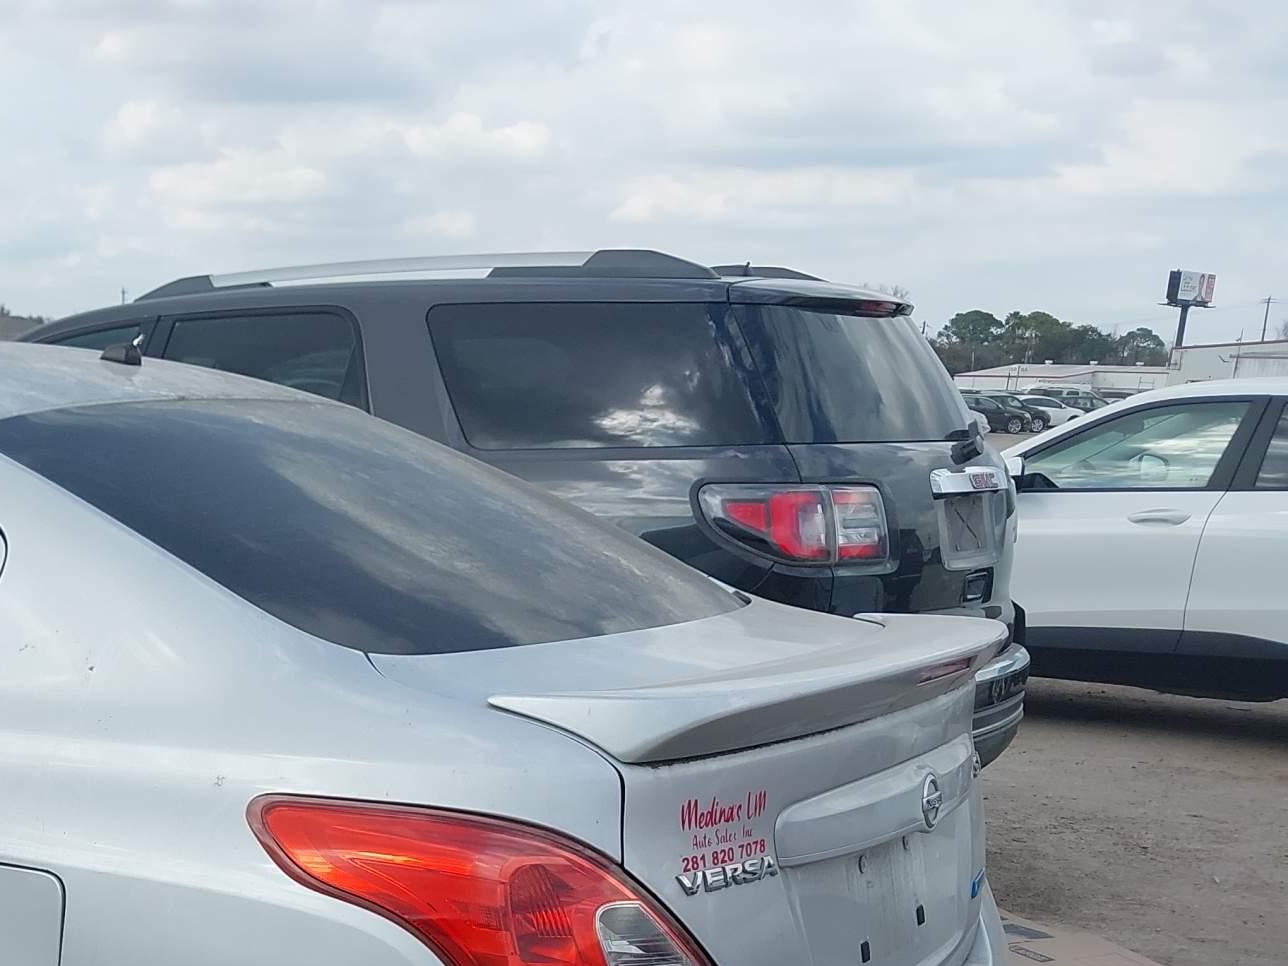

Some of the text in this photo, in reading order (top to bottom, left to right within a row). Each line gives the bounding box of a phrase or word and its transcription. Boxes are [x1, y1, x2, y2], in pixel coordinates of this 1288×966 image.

[682, 838, 766, 873] 281 820 7078
[692, 833, 712, 850] Auto
[715, 827, 737, 846] Sales
[675, 855, 778, 896] VERSA
